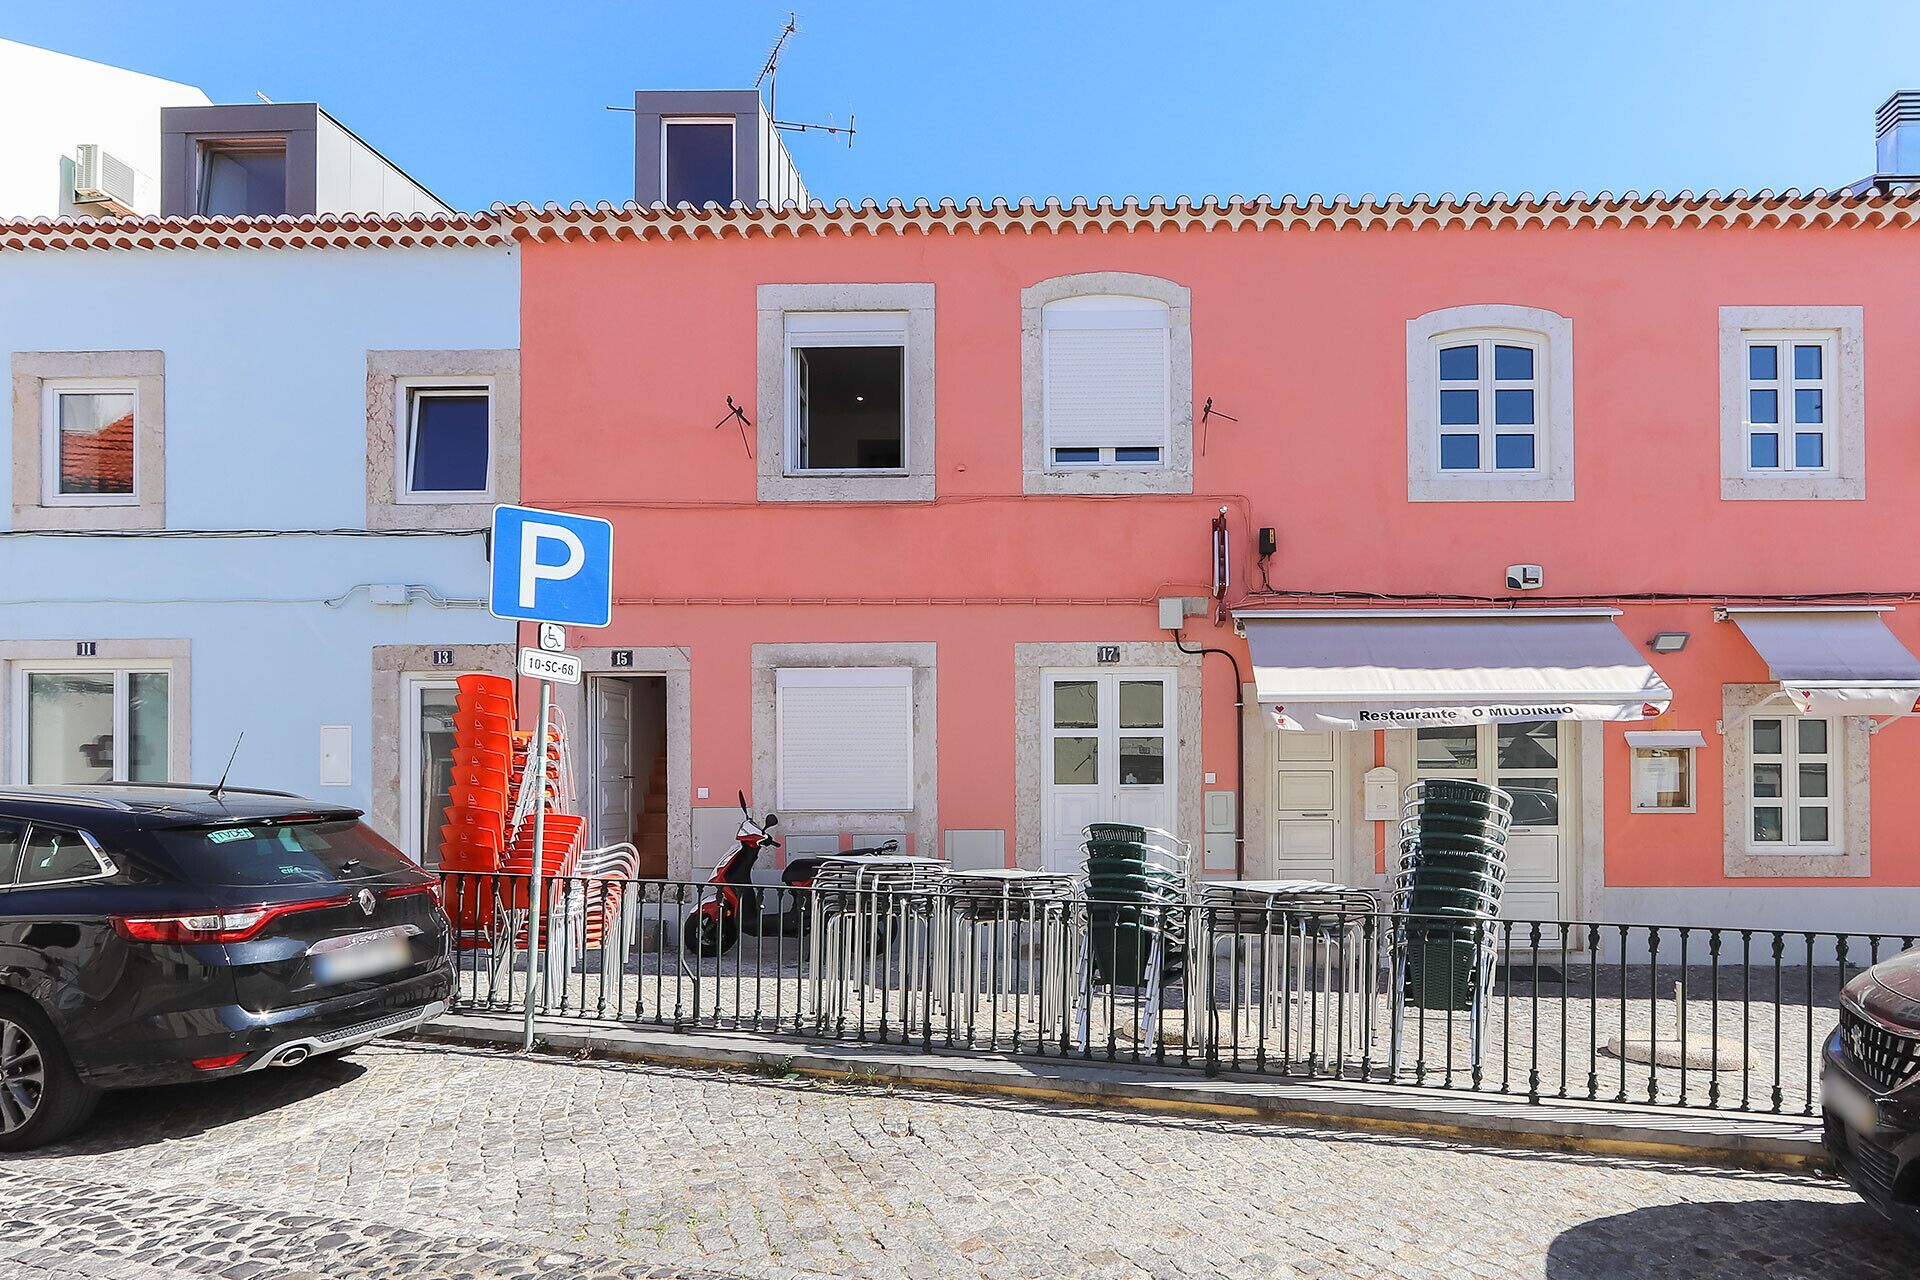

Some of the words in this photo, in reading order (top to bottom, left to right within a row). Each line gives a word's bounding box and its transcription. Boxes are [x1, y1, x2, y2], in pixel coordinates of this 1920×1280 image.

[518, 520, 585, 609] P
[81, 642, 91, 655] 11
[1101, 647, 1115, 661] 17
[437, 651, 449, 664] 13
[616, 652, 628, 665] 15
[529, 657, 574, 676] 10-SC-68
[1359, 709, 1457, 721] Restaurante
[1472, 708, 1484, 717] O
[1489, 705, 1574, 717] MIUDINHO
